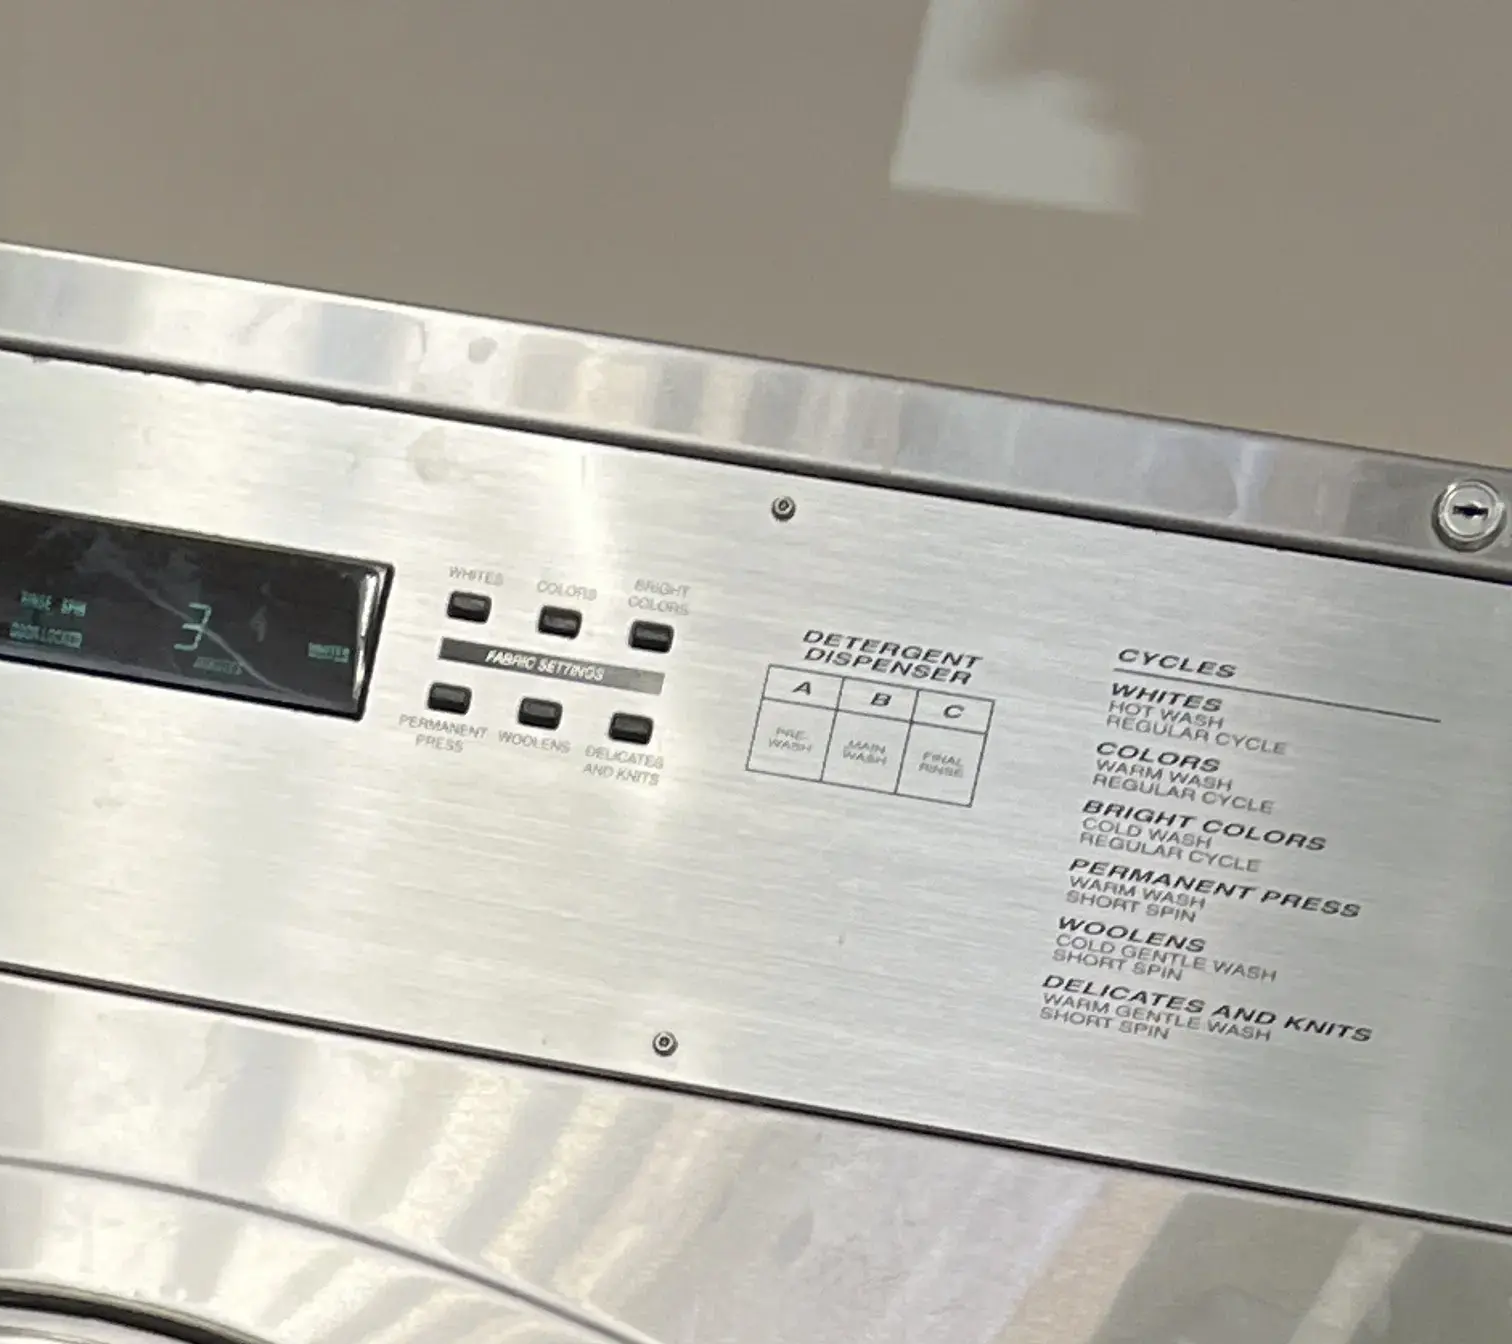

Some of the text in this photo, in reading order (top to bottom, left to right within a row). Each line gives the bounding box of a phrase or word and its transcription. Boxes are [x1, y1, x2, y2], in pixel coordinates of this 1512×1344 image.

[449, 567, 503, 586] WHITES
[537, 580, 597, 601] COLORS
[635, 580, 691, 598] BRIGHT
[628, 596, 689, 616] COLORS
[174, 602, 211, 651] 3
[803, 630, 983, 668] DETERGENT
[1117, 648, 1237, 679] CYCLES
[486, 650, 604, 681] FABRIC SETTINGS
[804, 647, 972, 685] DISPENSER
[793, 681, 812, 695] A
[870, 693, 892, 707] B
[1111, 682, 1223, 713] WHITES
[399, 714, 487, 740] PERMANENT
[943, 705, 965, 719] C
[1108, 700, 1225, 730] HOT WASH
[415, 734, 464, 752] PRESS
[498, 731, 571, 753] WOOLENS
[769, 738, 812, 754] WASH
[848, 739, 885, 754] MAIN
[1106, 715, 1287, 755] REGULAR CYCLE
[585, 745, 664, 769] DELICATES
[843, 750, 887, 766] WASH
[919, 762, 964, 778] RINSE
[923, 751, 963, 766] FINAL
[1096, 742, 1220, 773] COLORS
[583, 764, 659, 786] AND KNITS
[1096, 759, 1233, 791] WARM WASH
[1092, 773, 1275, 814] REGULAR CYCLE
[1082, 799, 1326, 851] BRIGHT COLORS
[1082, 817, 1212, 849] COLD WASH
[1079, 832, 1262, 873] REGULAR CYCLE
[1068, 858, 1362, 918] PERMANENT PRESS
[1070, 875, 1206, 909] WARM WASH
[1066, 890, 1196, 923] SHORT SPIN
[1059, 916, 1206, 952] WOOLENS
[1052, 949, 1183, 981] SHORT SPIN
[1056, 933, 1277, 982] COLD GENTLE WASH
[1040, 1007, 1169, 1040] SHORT SPIN
[1041, 974, 1373, 1043] DELICATES AND KNITS
[1043, 992, 1271, 1042] WARM GENTLE WASH
